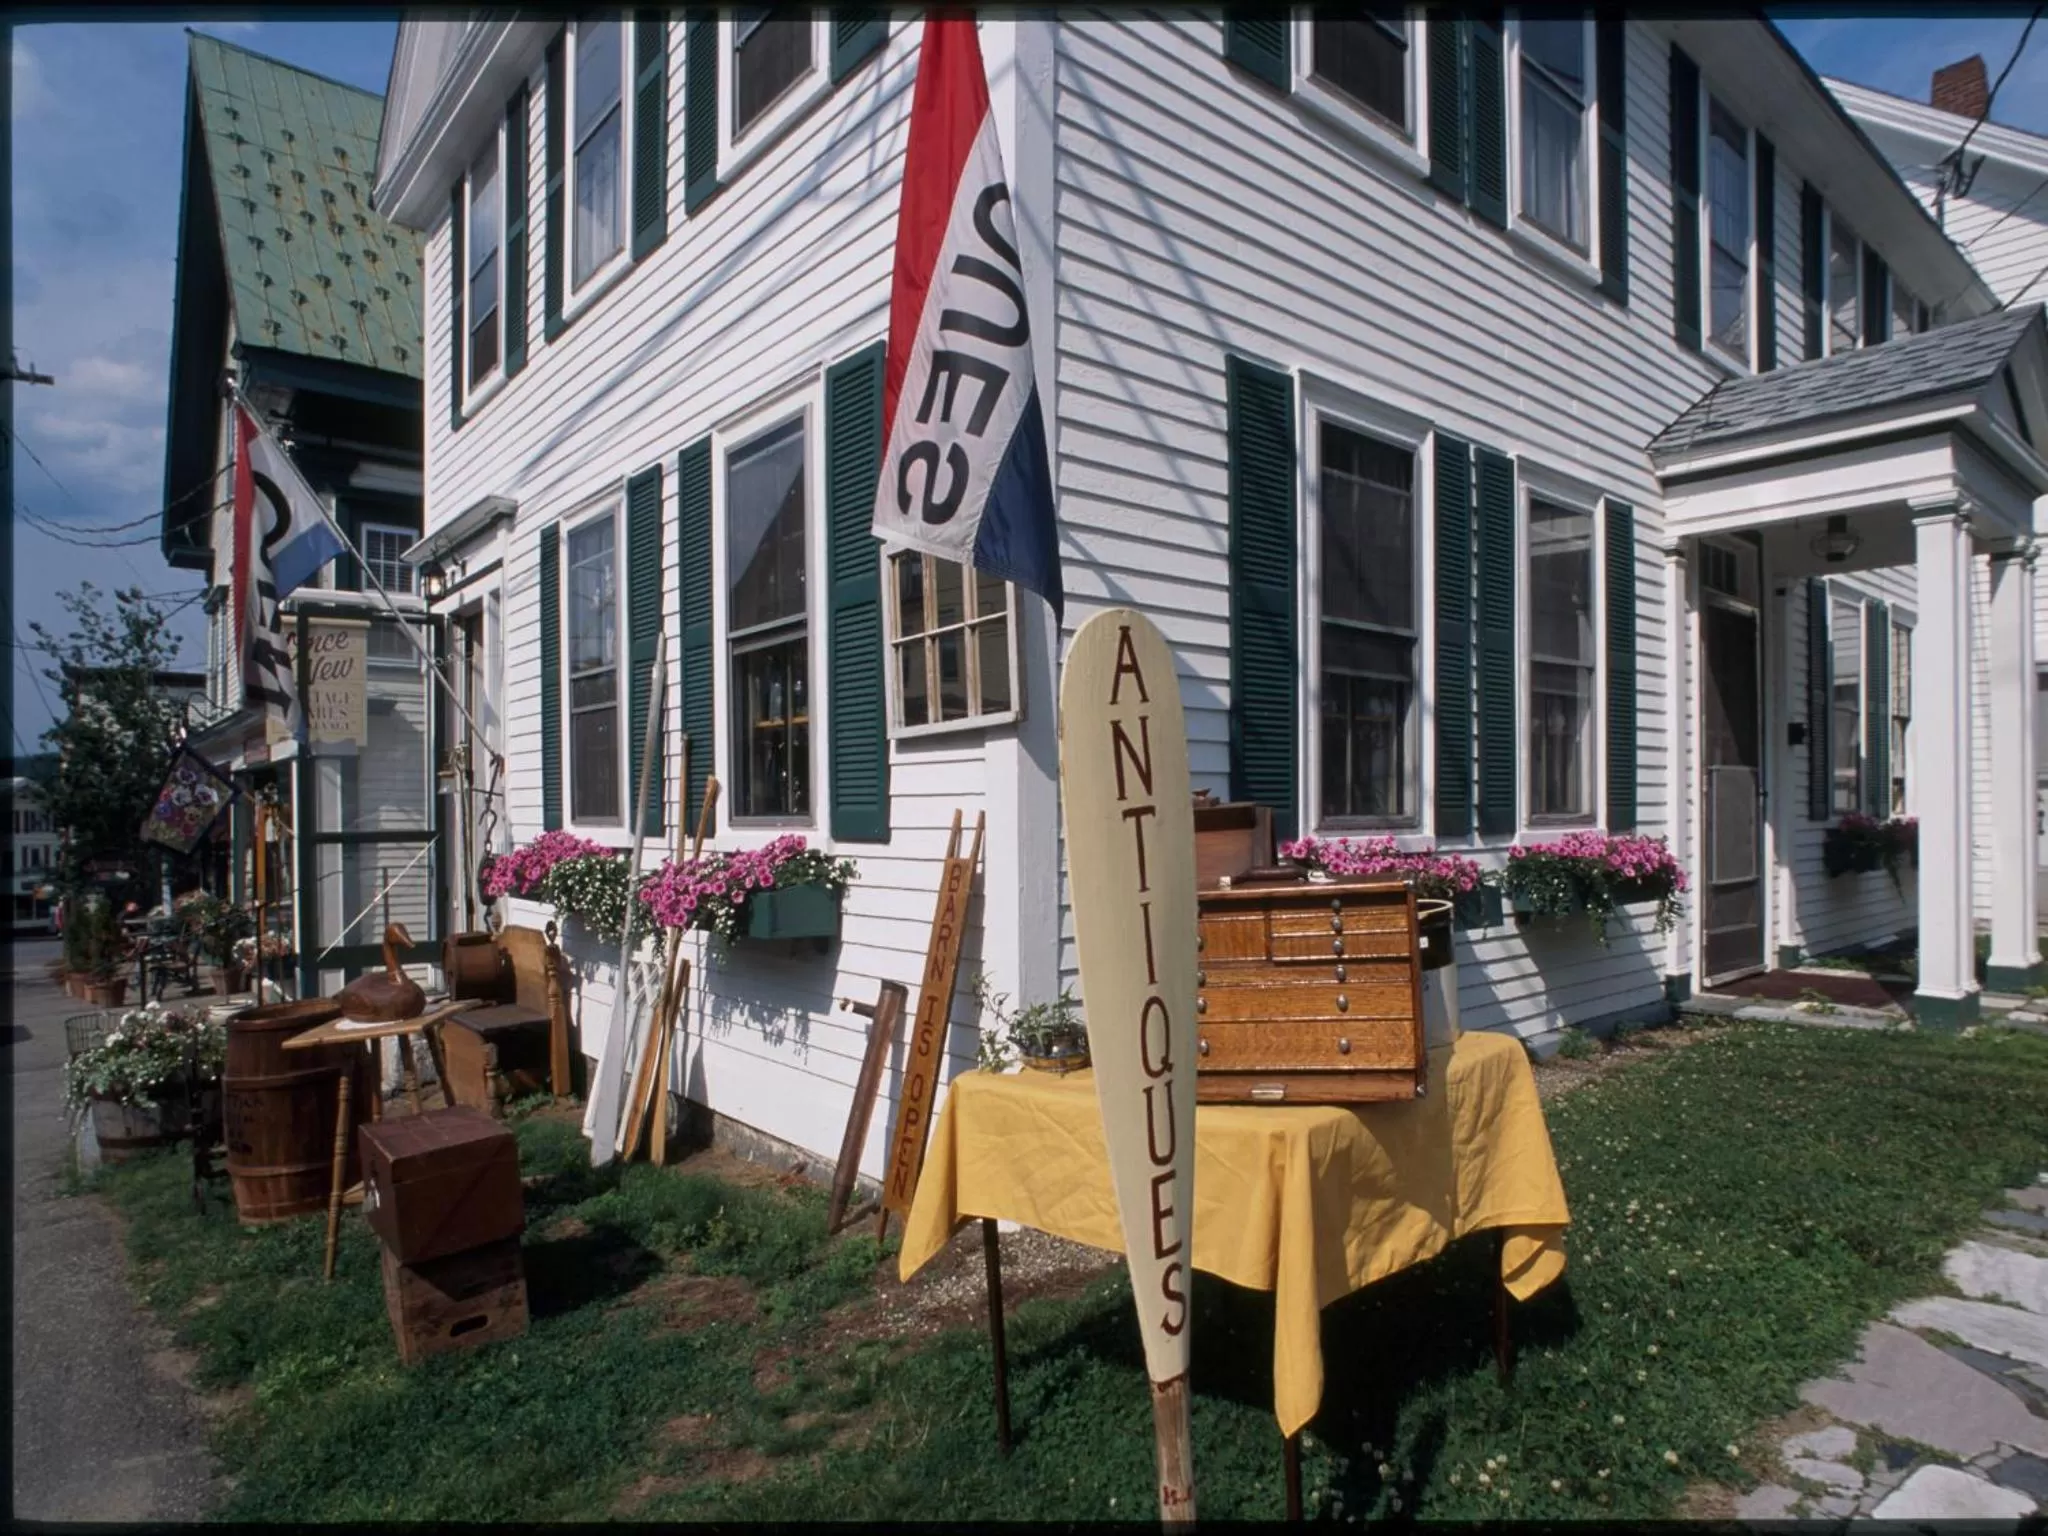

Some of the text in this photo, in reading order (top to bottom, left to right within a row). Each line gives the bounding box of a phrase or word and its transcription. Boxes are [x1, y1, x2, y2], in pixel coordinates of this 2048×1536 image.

[892, 863, 962, 1199] BARN IS OPEN
[1109, 625, 1187, 1337] ANTIQUES
